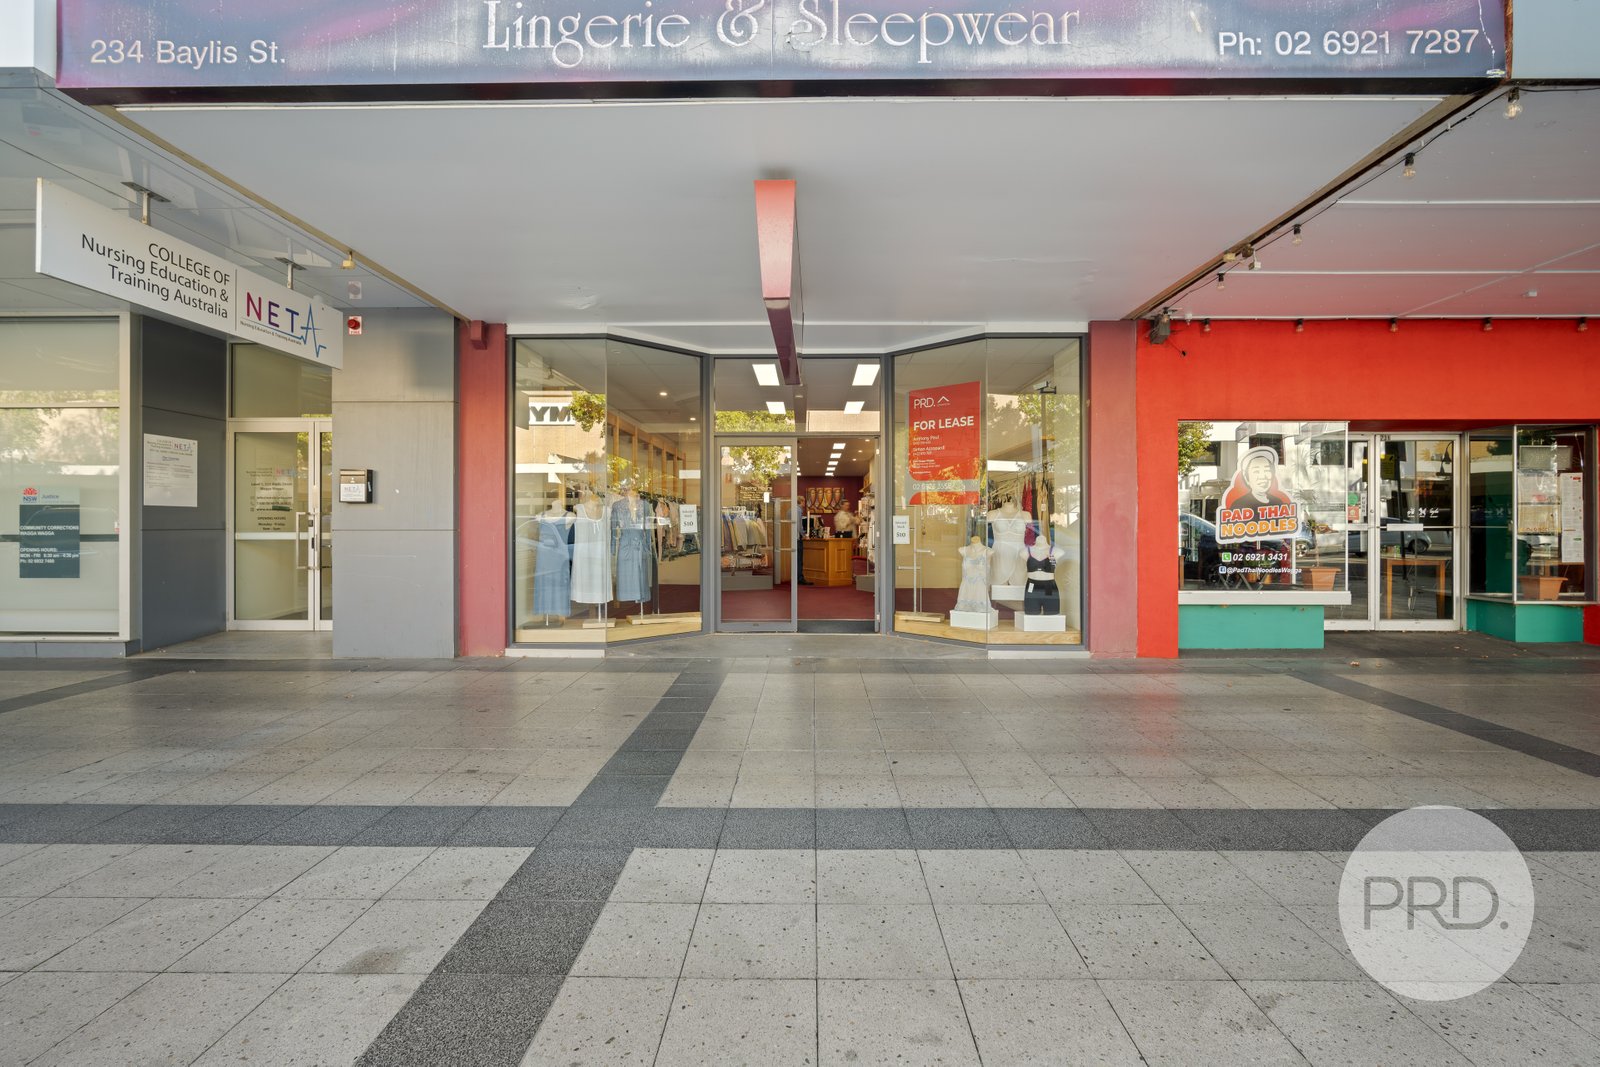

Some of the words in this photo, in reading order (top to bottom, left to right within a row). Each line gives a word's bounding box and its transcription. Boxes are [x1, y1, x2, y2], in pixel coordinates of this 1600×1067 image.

[483, 0, 690, 68] Lingerie
[717, 0, 764, 47] &
[789, 0, 1080, 63] Sleepwear
[1218, 31, 1263, 56] Ph:
[1274, 30, 1311, 55] 02
[1323, 30, 1390, 55] 6921
[1406, 29, 1480, 54] 7287
[90, 40, 143, 64] 234
[157, 40, 238, 70] Baylis
[249, 40, 286, 64] St.
[82, 233, 145, 273] Nursing
[150, 261, 217, 299] Education
[220, 288, 229, 302] &
[148, 243, 210, 279] COLLEGE
[213, 269, 230, 286] OF
[108, 264, 170, 301] Training
[174, 288, 229, 319] Australia
[914, 420, 936, 431] FOR
[938, 415, 975, 429] LEASE
[1221, 507, 1254, 523] PAD
[1258, 504, 1296, 519] THAI
[1221, 518, 1297, 537] NOODLES
[1233, 553, 1244, 561] 02
[1245, 553, 1265, 561] 6921
[1268, 553, 1288, 561] 3431
